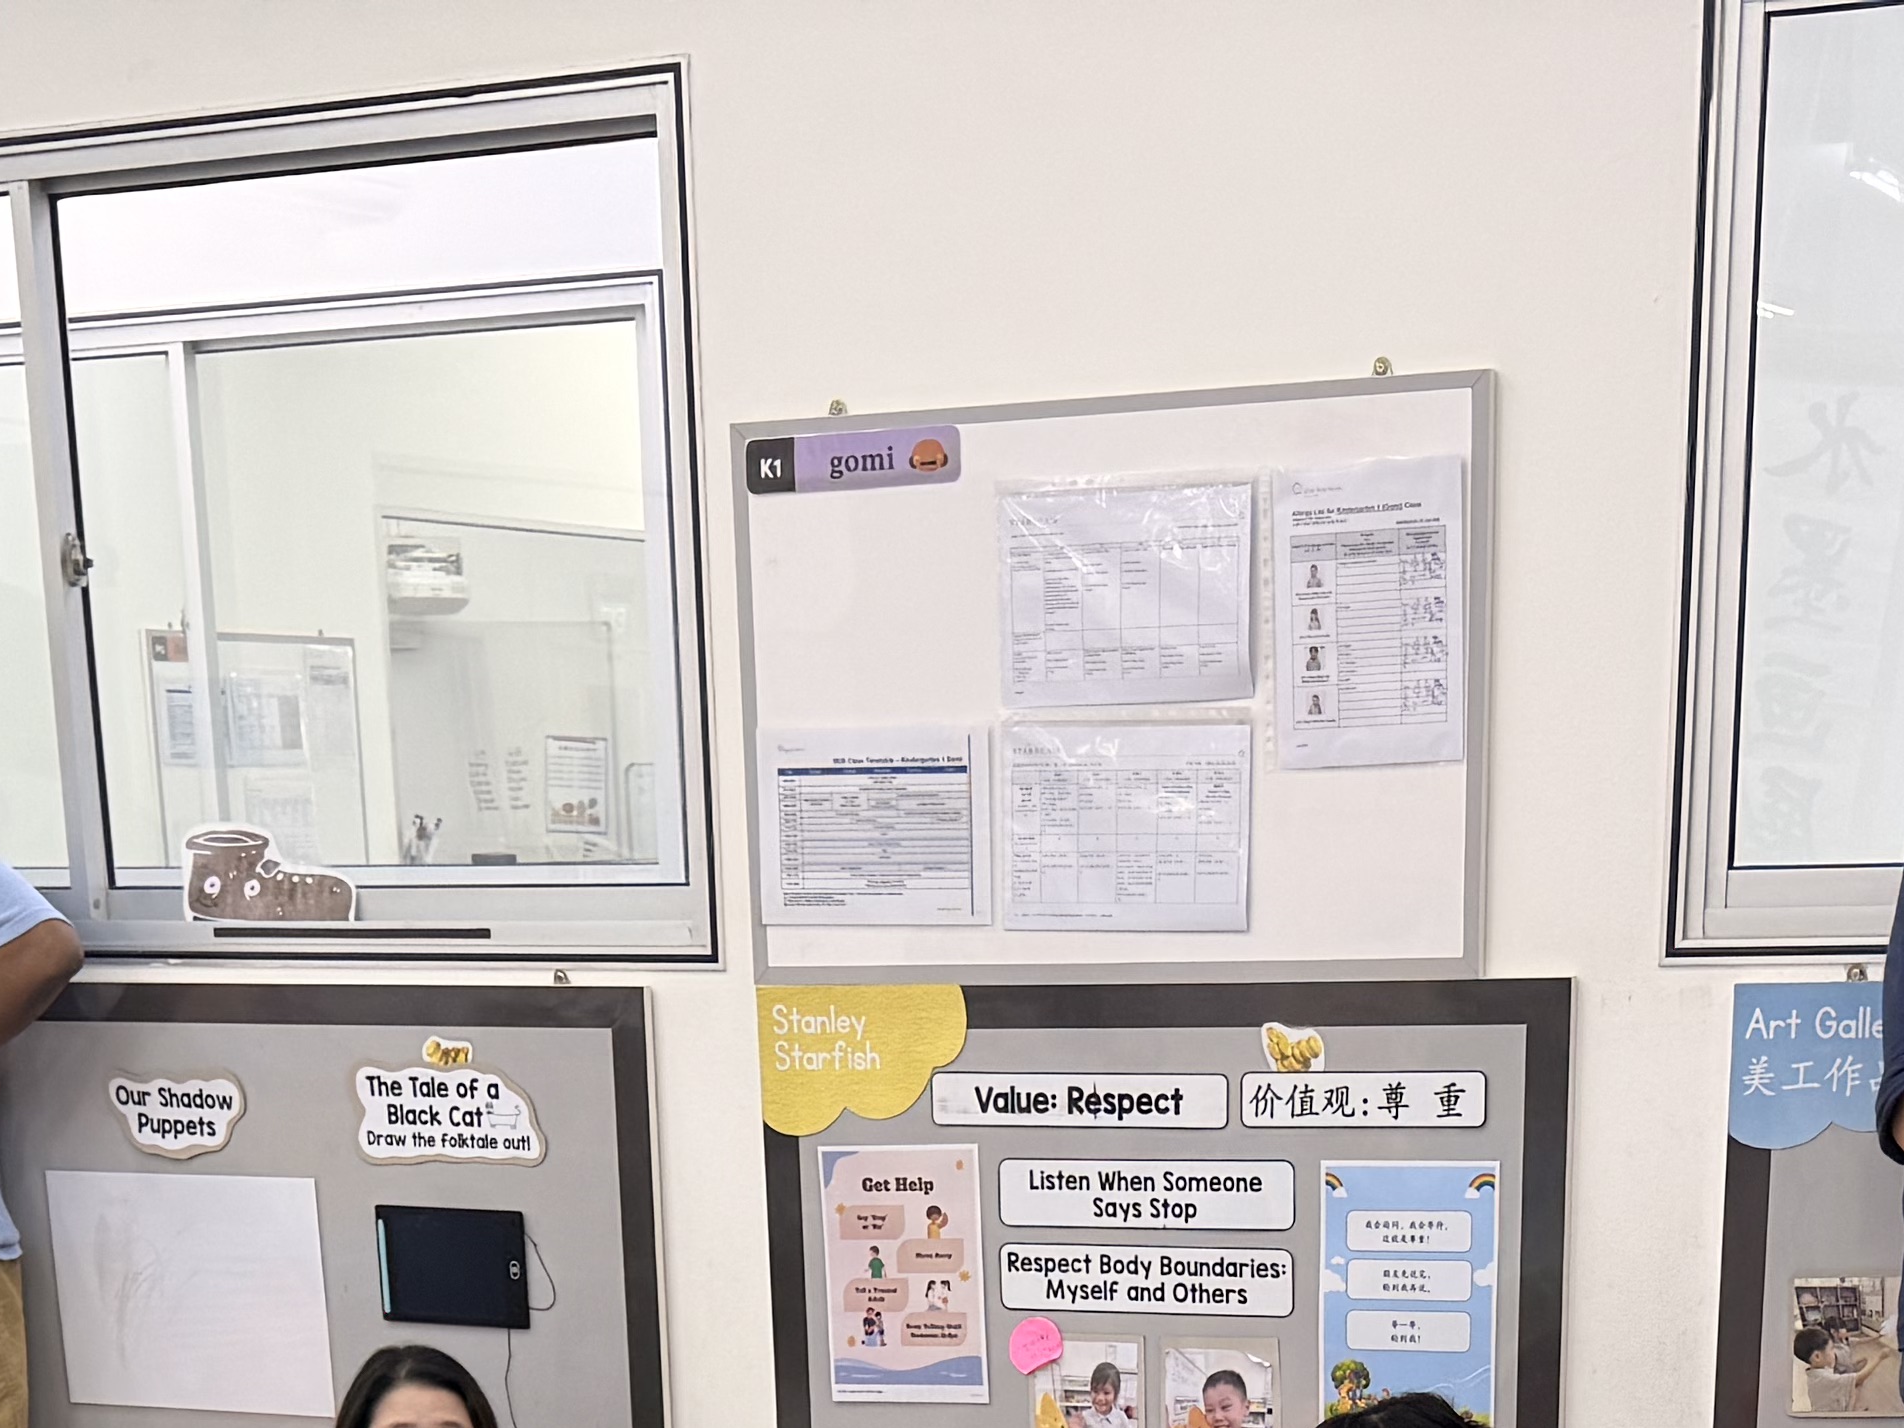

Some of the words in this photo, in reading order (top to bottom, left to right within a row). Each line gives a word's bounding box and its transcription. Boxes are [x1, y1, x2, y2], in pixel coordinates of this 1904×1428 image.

[760, 458, 782, 479] K1
[830, 446, 895, 480] gomi
[772, 1003, 867, 1041] Stanley
[1745, 1007, 1802, 1040] Art
[774, 1040, 881, 1072] Starfish
[116, 1085, 151, 1107] Our
[159, 1087, 234, 1111] Shadow
[365, 1076, 403, 1098] The
[408, 1077, 451, 1100] Tale
[456, 1077, 479, 1100] of
[486, 1083, 500, 1100] a
[975, 1086, 1057, 1116] Value:
[1067, 1086, 1184, 1117] Respect
[138, 1113, 216, 1139] Puppets
[388, 1104, 443, 1127] Black
[448, 1106, 484, 1128] Cat
[367, 1131, 407, 1148] Draw
[412, 1131, 437, 1148] the
[441, 1132, 498, 1150] folktale
[503, 1134, 531, 1151] out!
[862, 1177, 891, 1192] Get
[894, 1176, 934, 1195] Help
[1029, 1169, 1091, 1193] Listen
[1098, 1170, 1156, 1193] When
[1162, 1171, 1263, 1194] Someone
[1092, 1196, 1142, 1222] Says
[1149, 1196, 1198, 1222] Stop
[1007, 1253, 1092, 1278] Respect
[1099, 1253, 1152, 1281] Body
[1160, 1255, 1287, 1280] Boundaries:
[1045, 1279, 1119, 1304] Myself
[1127, 1281, 1165, 1303] and
[1172, 1282, 1249, 1306] Others
